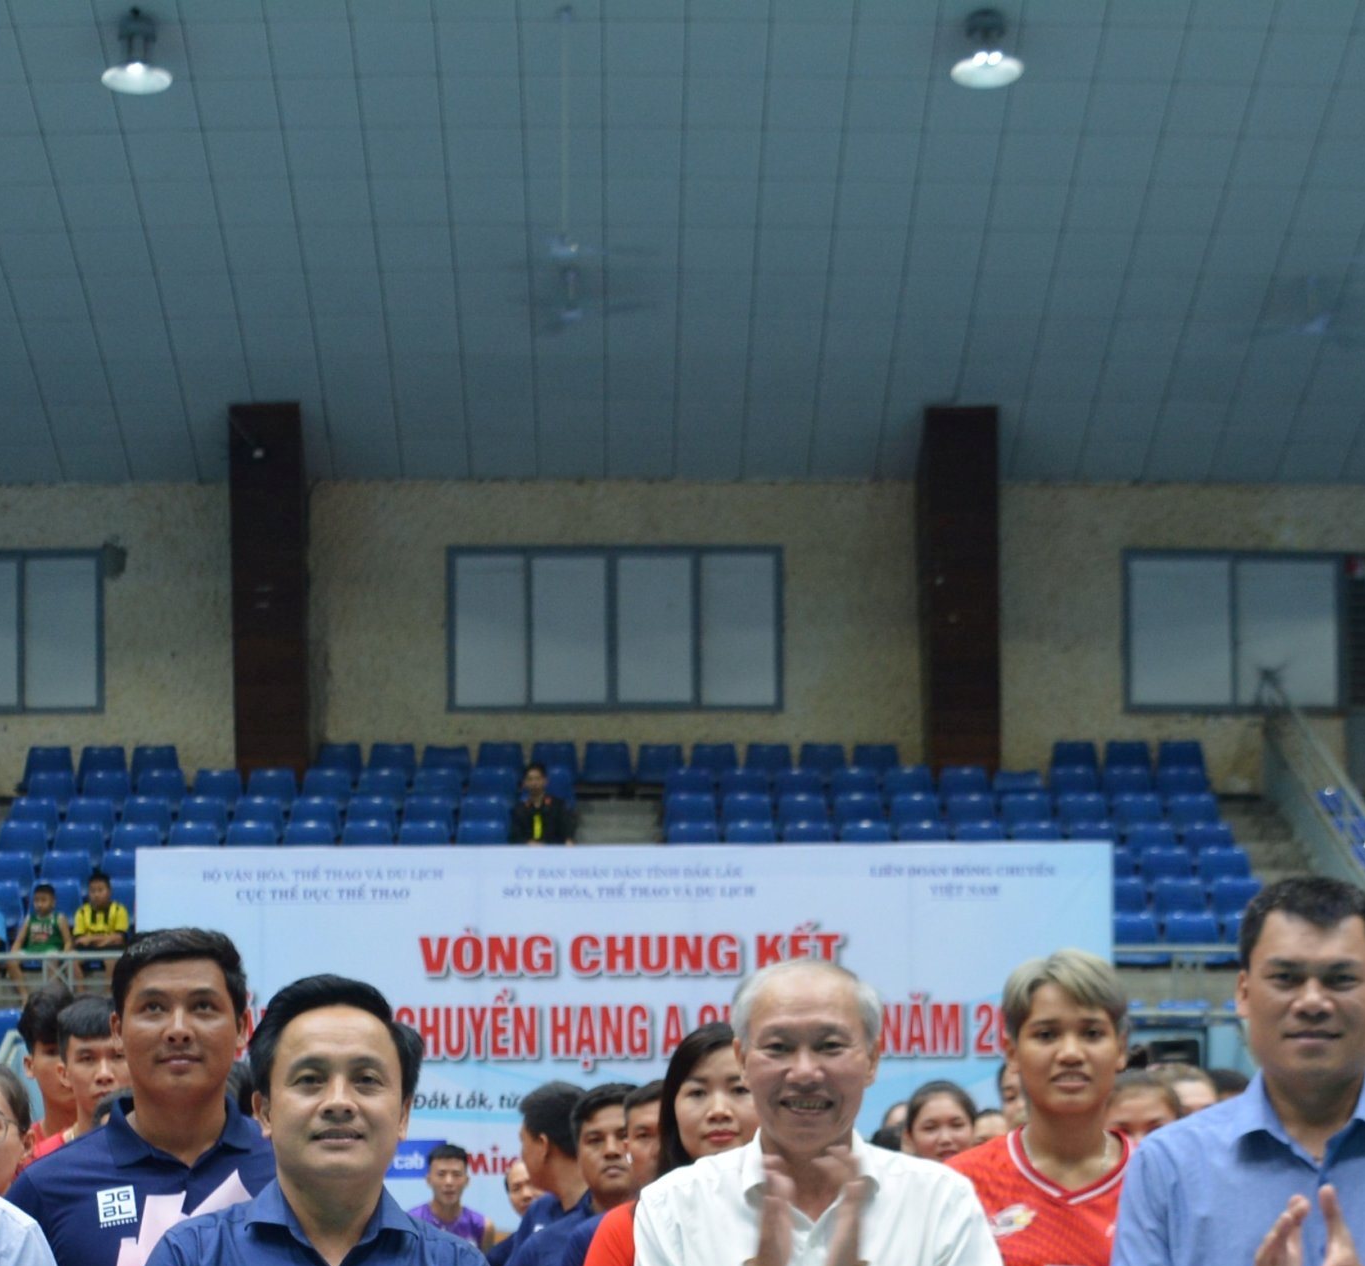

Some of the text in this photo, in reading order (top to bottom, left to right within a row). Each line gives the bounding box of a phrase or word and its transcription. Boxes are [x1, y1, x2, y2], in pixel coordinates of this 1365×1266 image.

[235, 888, 265, 905] CỤC
[302, 888, 331, 904] DỤC
[370, 888, 410, 900] THAO
[419, 922, 840, 976] VÒNG CHUNG KẾT
[552, 1004, 648, 1070] HẠNG
[662, 1004, 684, 1056] A
[880, 993, 961, 1056] NĂM
[102, 1190, 131, 1206] JG
